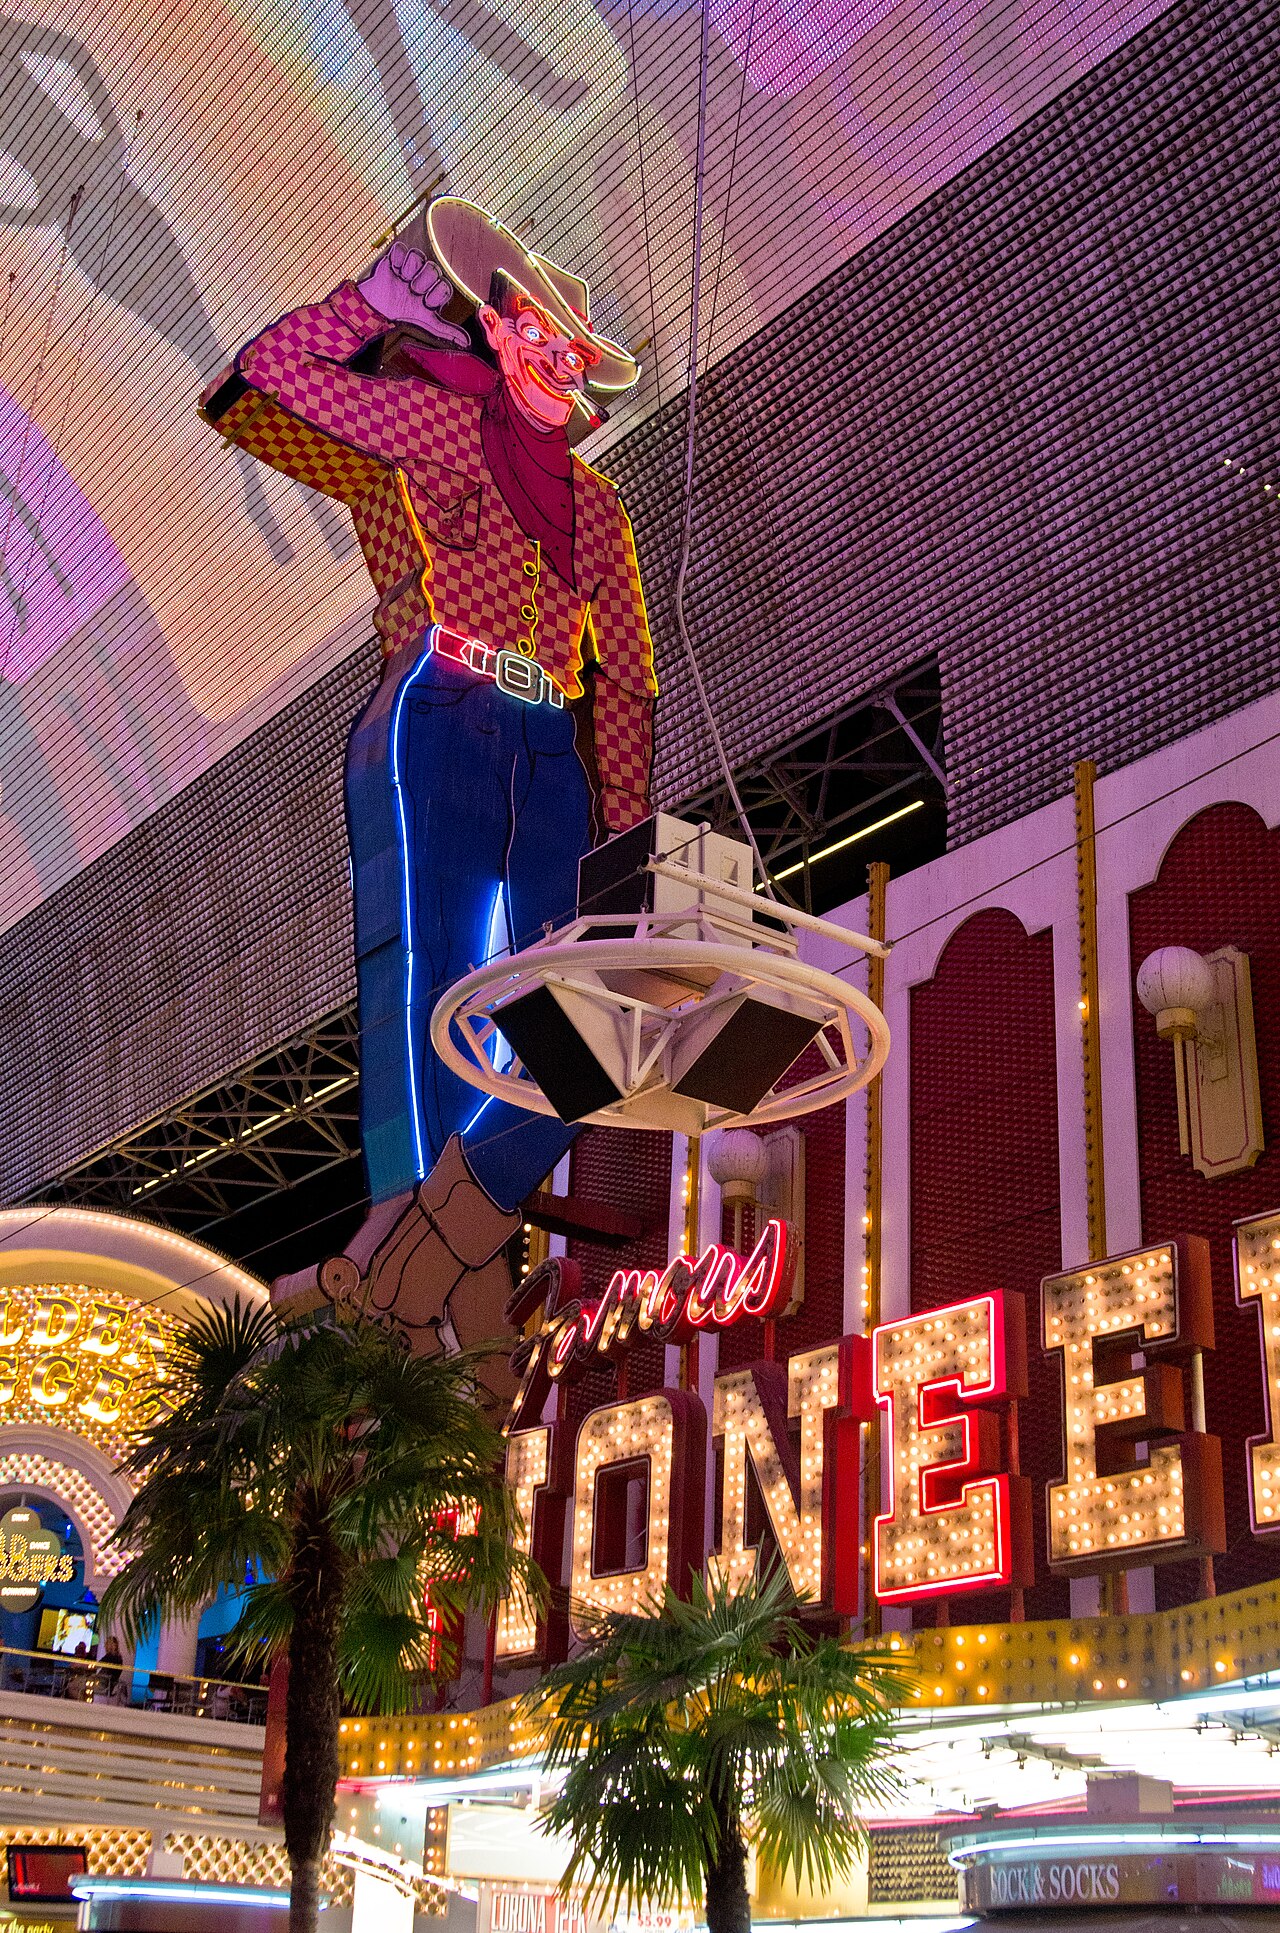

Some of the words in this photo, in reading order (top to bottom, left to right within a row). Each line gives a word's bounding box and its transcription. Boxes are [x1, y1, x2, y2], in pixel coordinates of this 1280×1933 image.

[503, 1218, 787, 1437] Famous
[1050, 1863, 1120, 1900] SOCKS
[491, 1893, 546, 1932] CORONA
